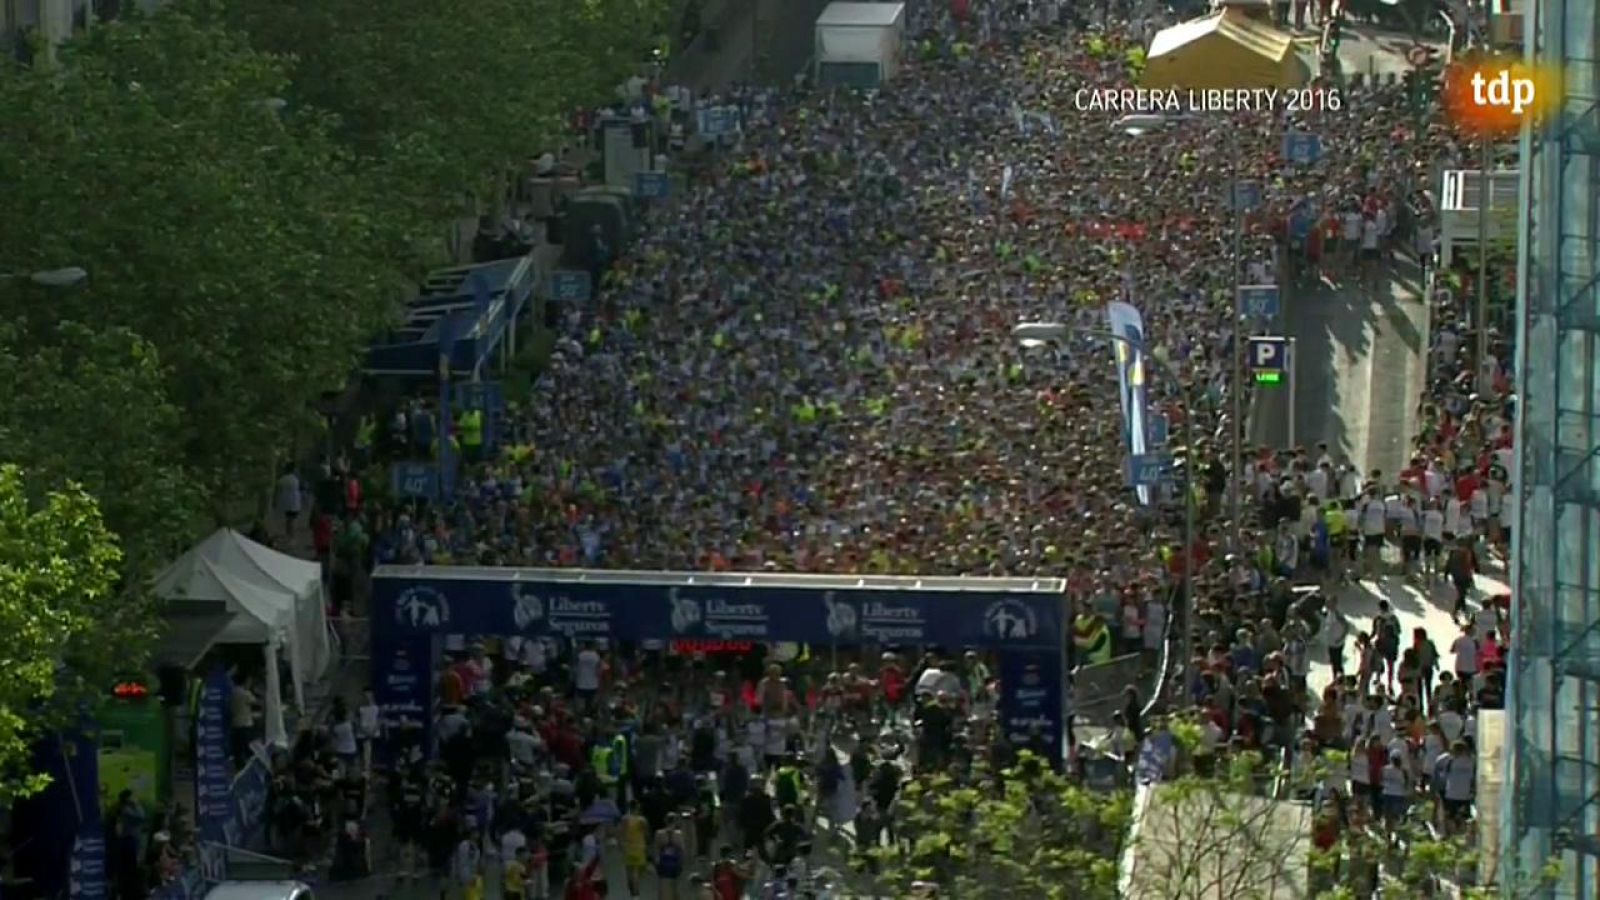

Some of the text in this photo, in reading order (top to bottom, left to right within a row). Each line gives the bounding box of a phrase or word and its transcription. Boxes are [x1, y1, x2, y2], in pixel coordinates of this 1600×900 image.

[1257, 343, 1276, 366] P
[548, 597, 605, 613] Liberty
[704, 599, 762, 616] Liberty
[861, 602, 919, 618] Liberty
[548, 616, 610, 635] Seguros
